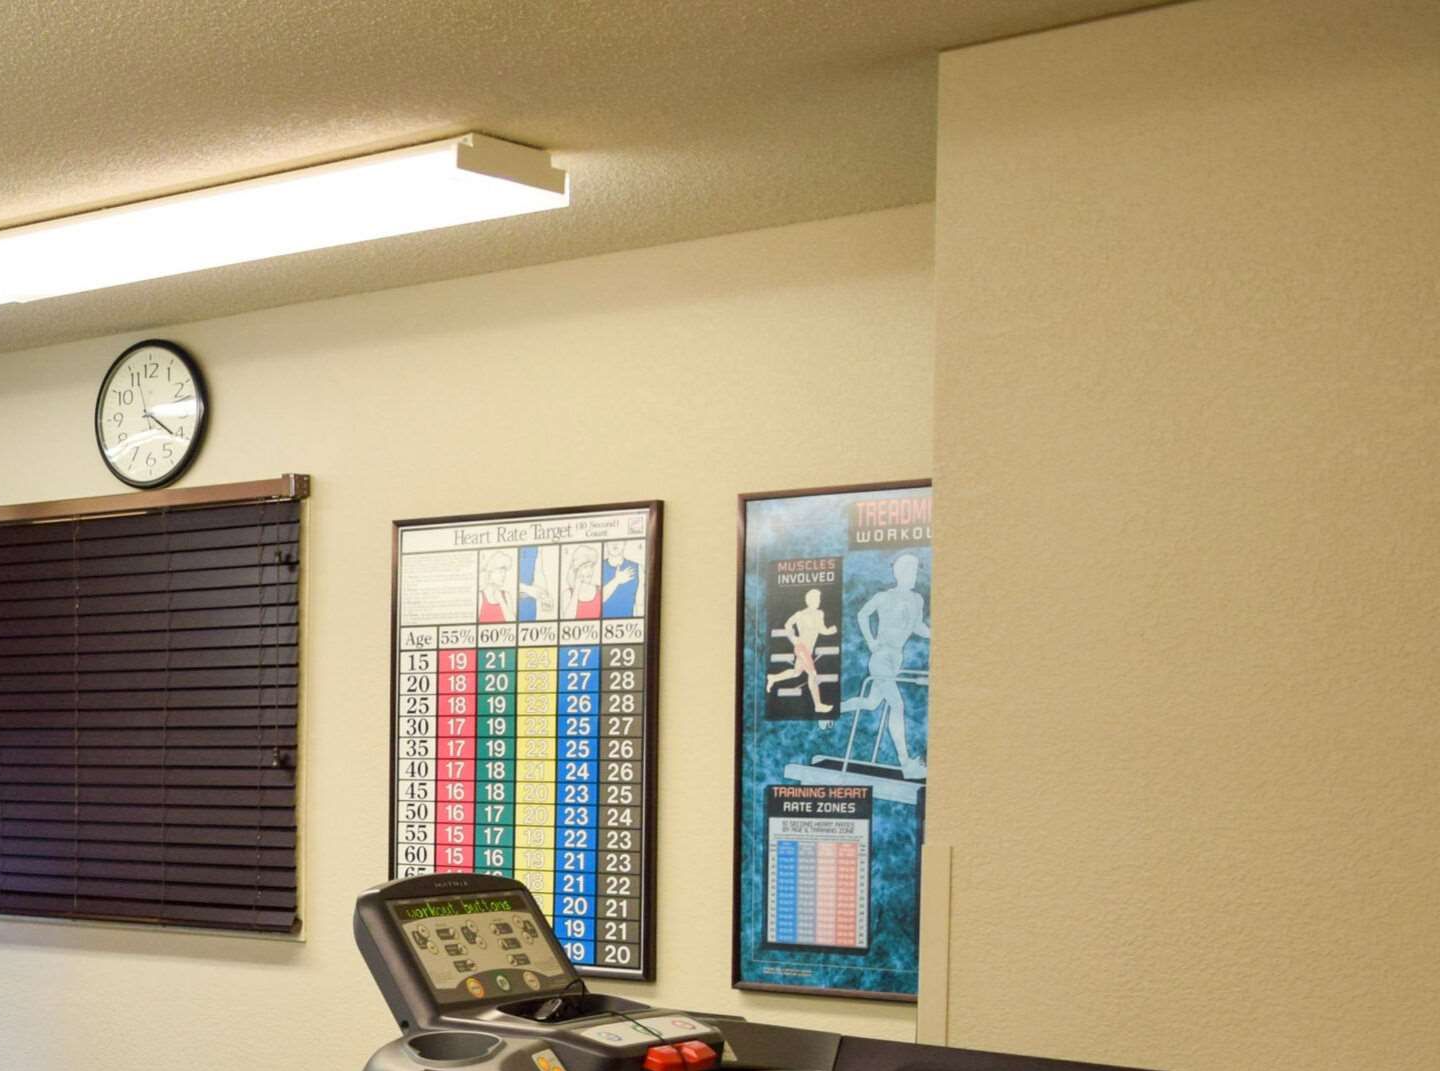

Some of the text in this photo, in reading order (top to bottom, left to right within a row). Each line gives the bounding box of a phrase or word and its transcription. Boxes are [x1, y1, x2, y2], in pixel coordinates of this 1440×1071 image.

[130, 372, 141, 388] 11
[144, 363, 159, 379] 12
[118, 390, 134, 406] 10
[174, 382, 184, 398] 2
[113, 412, 124, 428] 9
[175, 425, 185, 439] 4
[131, 446, 141, 462] 7
[145, 452, 157, 467] 6
[162, 442, 173, 459] 5
[453, 529, 490, 546] Heart
[497, 526, 526, 543] Rate
[530, 524, 572, 542] Target
[777, 559, 835, 572] MUSCLES
[777, 571, 835, 584] INVOLVED
[405, 623, 642, 648] Age 55% 60% 70% 80% 85%
[407, 648, 635, 671] 15 19 21 24 27 29
[407, 671, 634, 692] 20 18 20 23 27 28
[407, 695, 634, 714] 25 18 19 23 26 28
[406, 717, 633, 736] 30 17 19 22 25 27
[406, 740, 633, 758] 35 17 19 22 25 26
[406, 761, 633, 780] 40 17 18 21 24 26
[406, 783, 632, 804] 45 16 18 20 23 25
[772, 786, 868, 799] TRAINING HEART
[406, 804, 632, 826] 50 16 17 20 23 24
[783, 801, 856, 813] RATE ZONES
[405, 822, 427, 839] 55
[446, 827, 463, 842] 15
[485, 827, 504, 844] 17
[565, 830, 587, 847] 22
[607, 831, 631, 849] 23
[405, 844, 427, 861] 60
[446, 848, 463, 864] 15
[484, 849, 503, 866] 16
[564, 852, 584, 869] 21
[606, 853, 631, 872] 23
[564, 874, 583, 892] 21
[606, 876, 630, 895] 22
[563, 897, 587, 915] 20
[606, 899, 627, 917] 21
[565, 920, 626, 940] 19 21
[564, 942, 630, 964] 19 20
